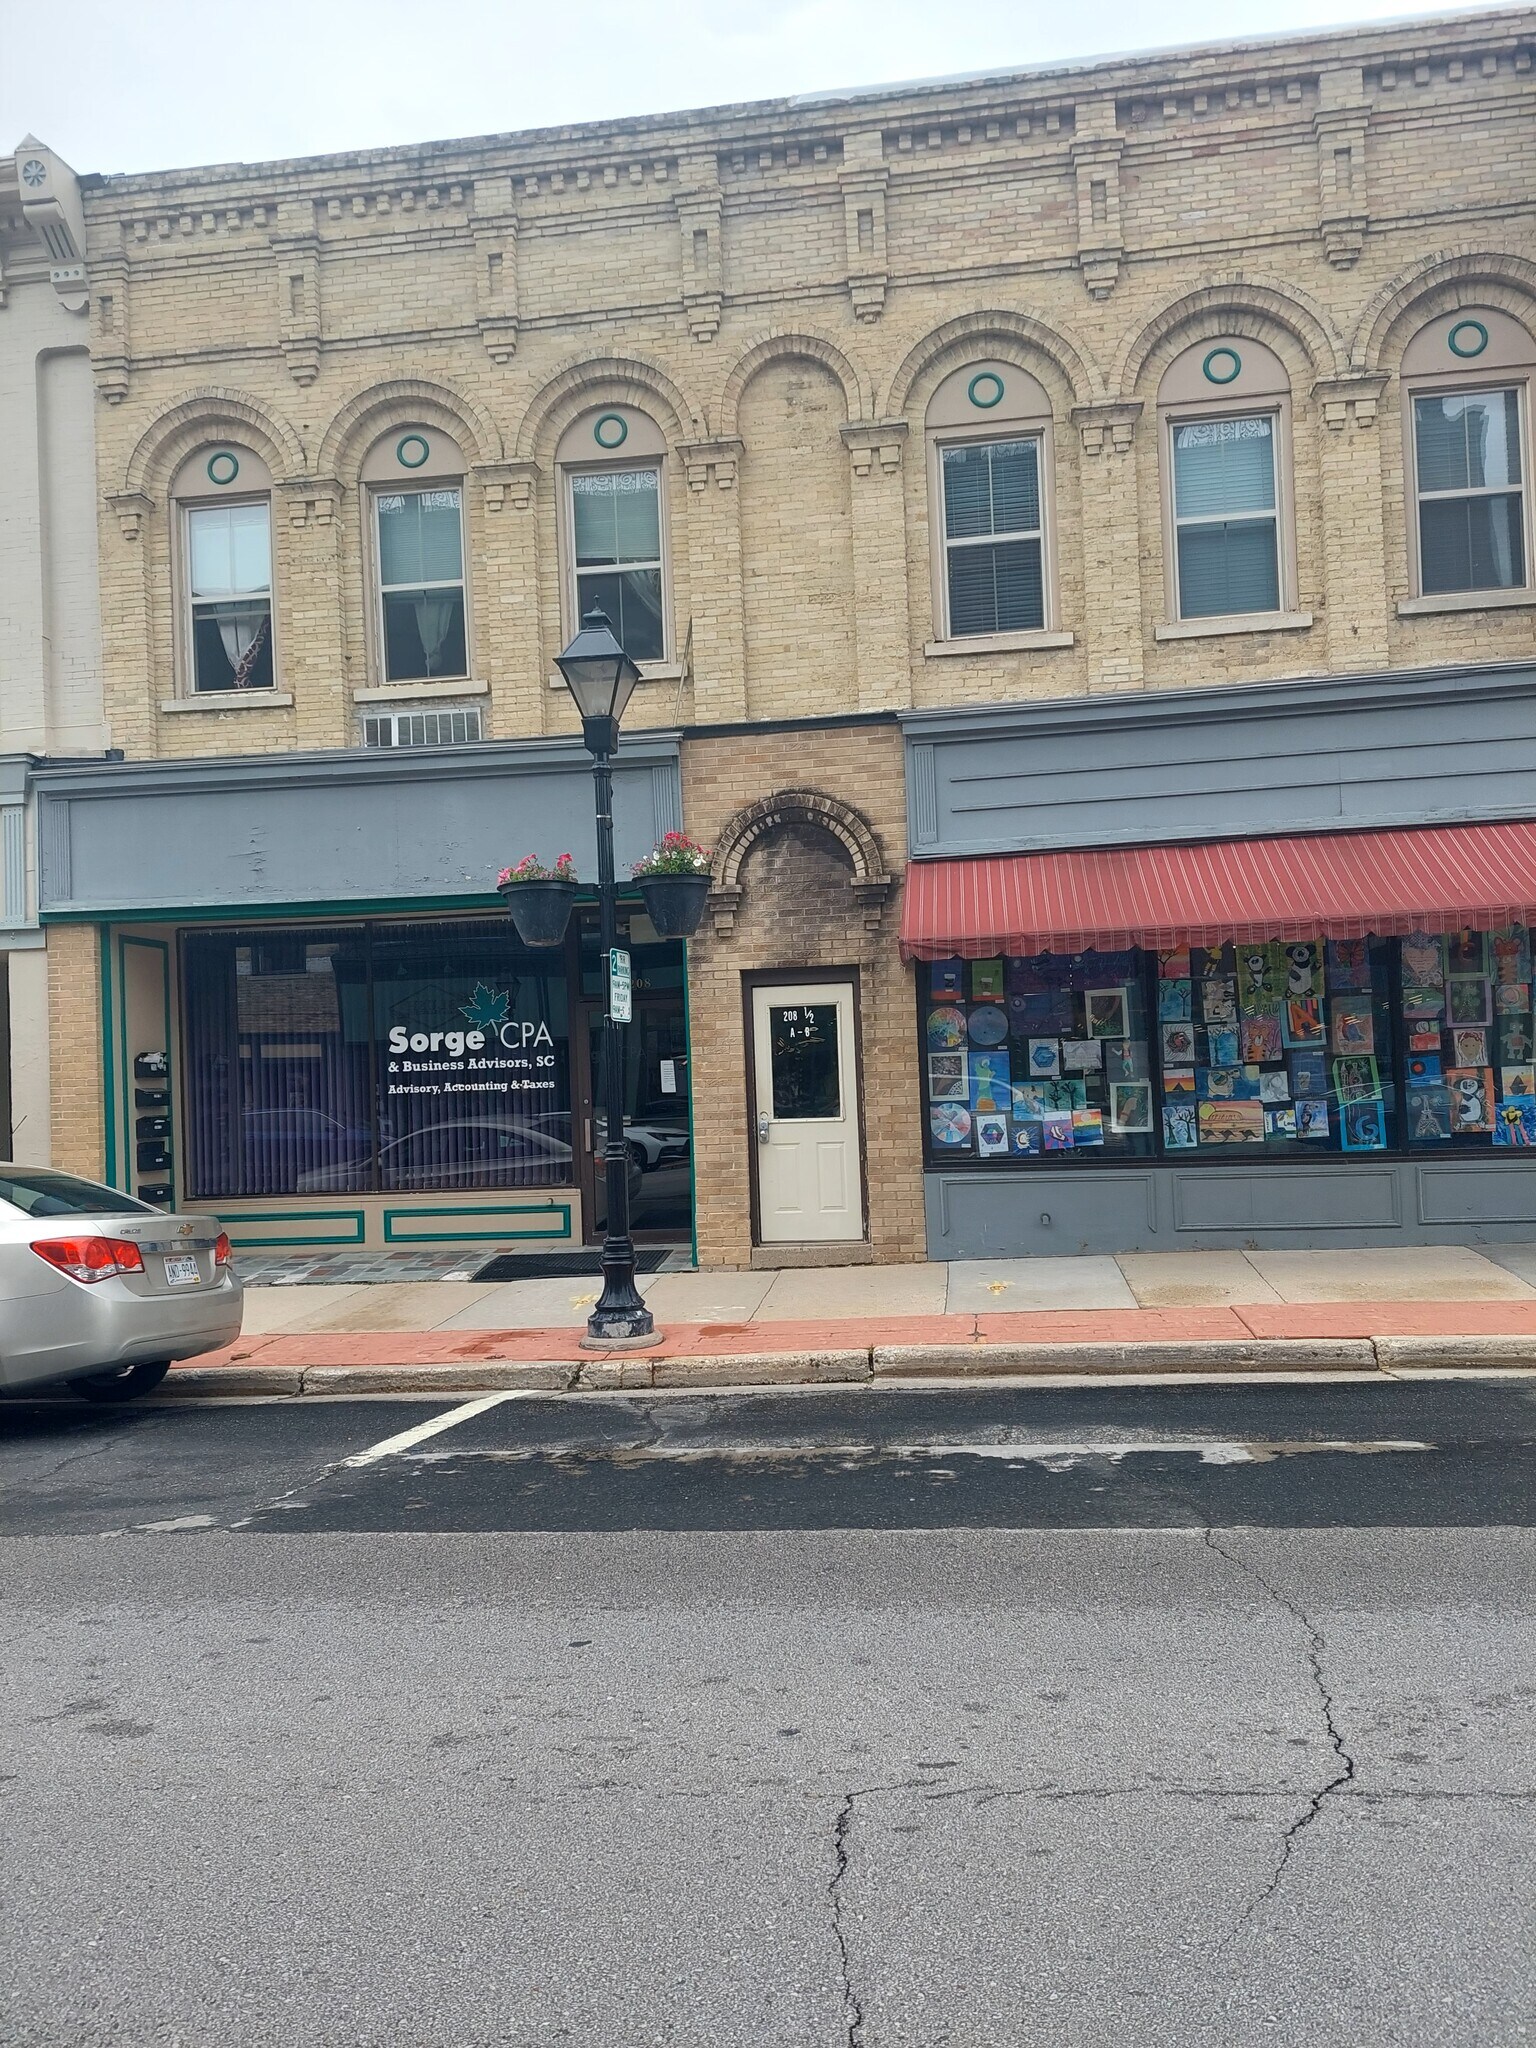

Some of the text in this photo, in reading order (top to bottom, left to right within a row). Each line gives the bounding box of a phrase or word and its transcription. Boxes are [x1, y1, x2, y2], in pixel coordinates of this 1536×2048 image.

[611, 954, 617, 972] 2
[783, 1010, 798, 1022] 208
[388, 1020, 554, 1057] Sorge CPA
[790, 1027, 796, 1038] A
[387, 1055, 555, 1073] & Business Advisors, SC
[387, 1083, 442, 1095] Advisory,
[443, 1080, 508, 1093] Accounting
[521, 1079, 555, 1089] Taxes
